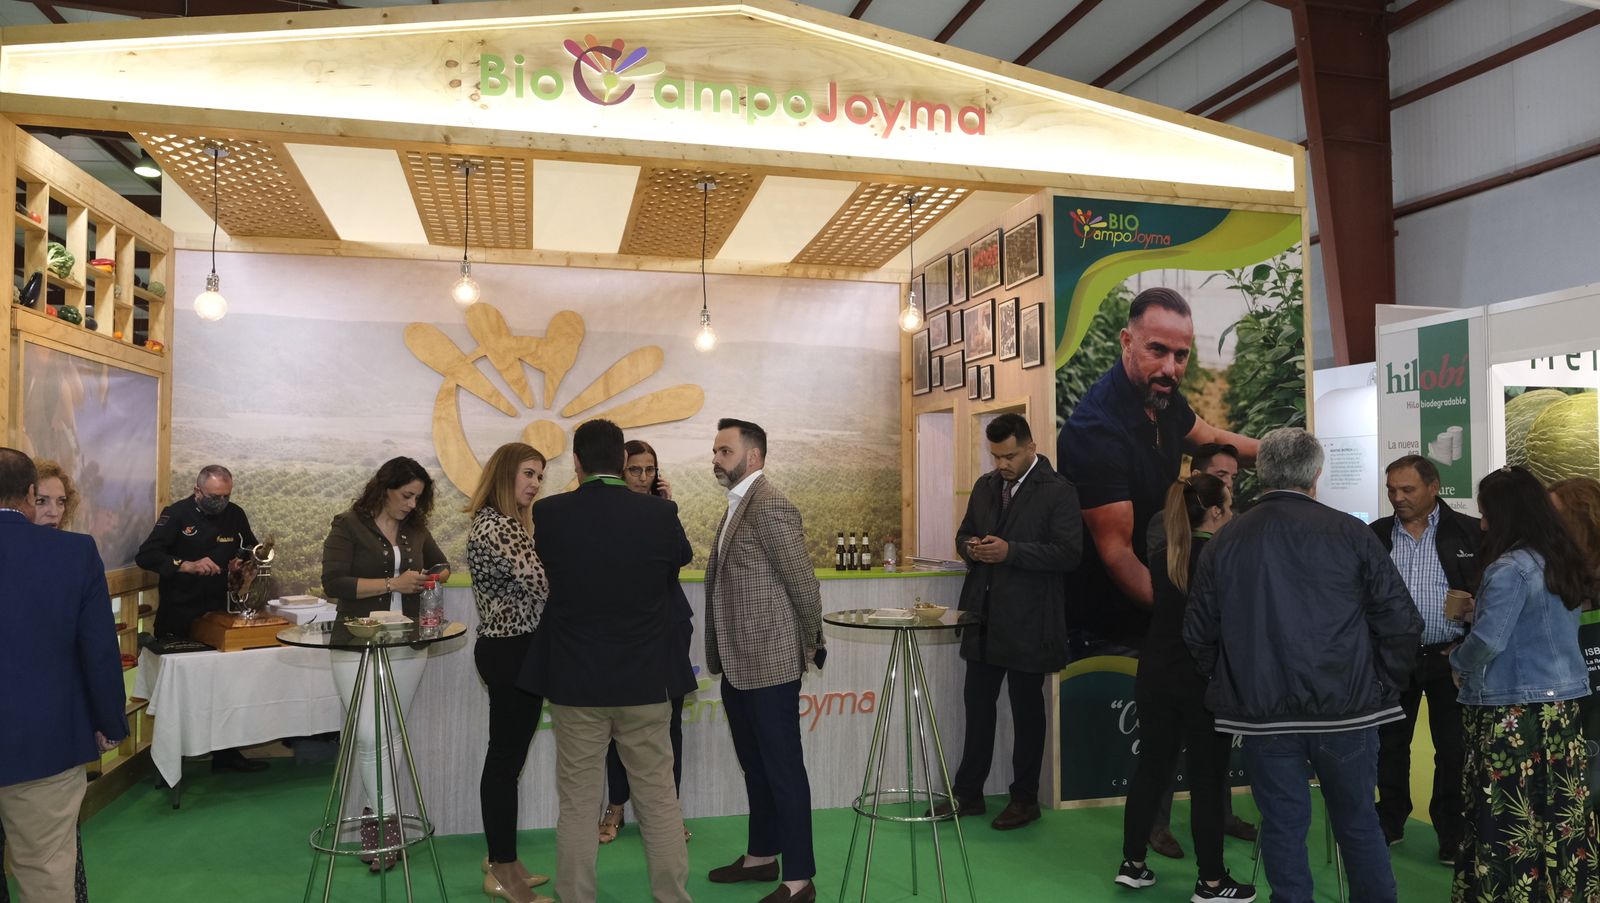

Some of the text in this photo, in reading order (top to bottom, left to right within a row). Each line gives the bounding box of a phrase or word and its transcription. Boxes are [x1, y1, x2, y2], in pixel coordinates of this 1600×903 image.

[1108, 213, 1139, 231] BIO
[1420, 396, 1467, 409] biodegradable
[1387, 440, 1420, 450] La nueva
